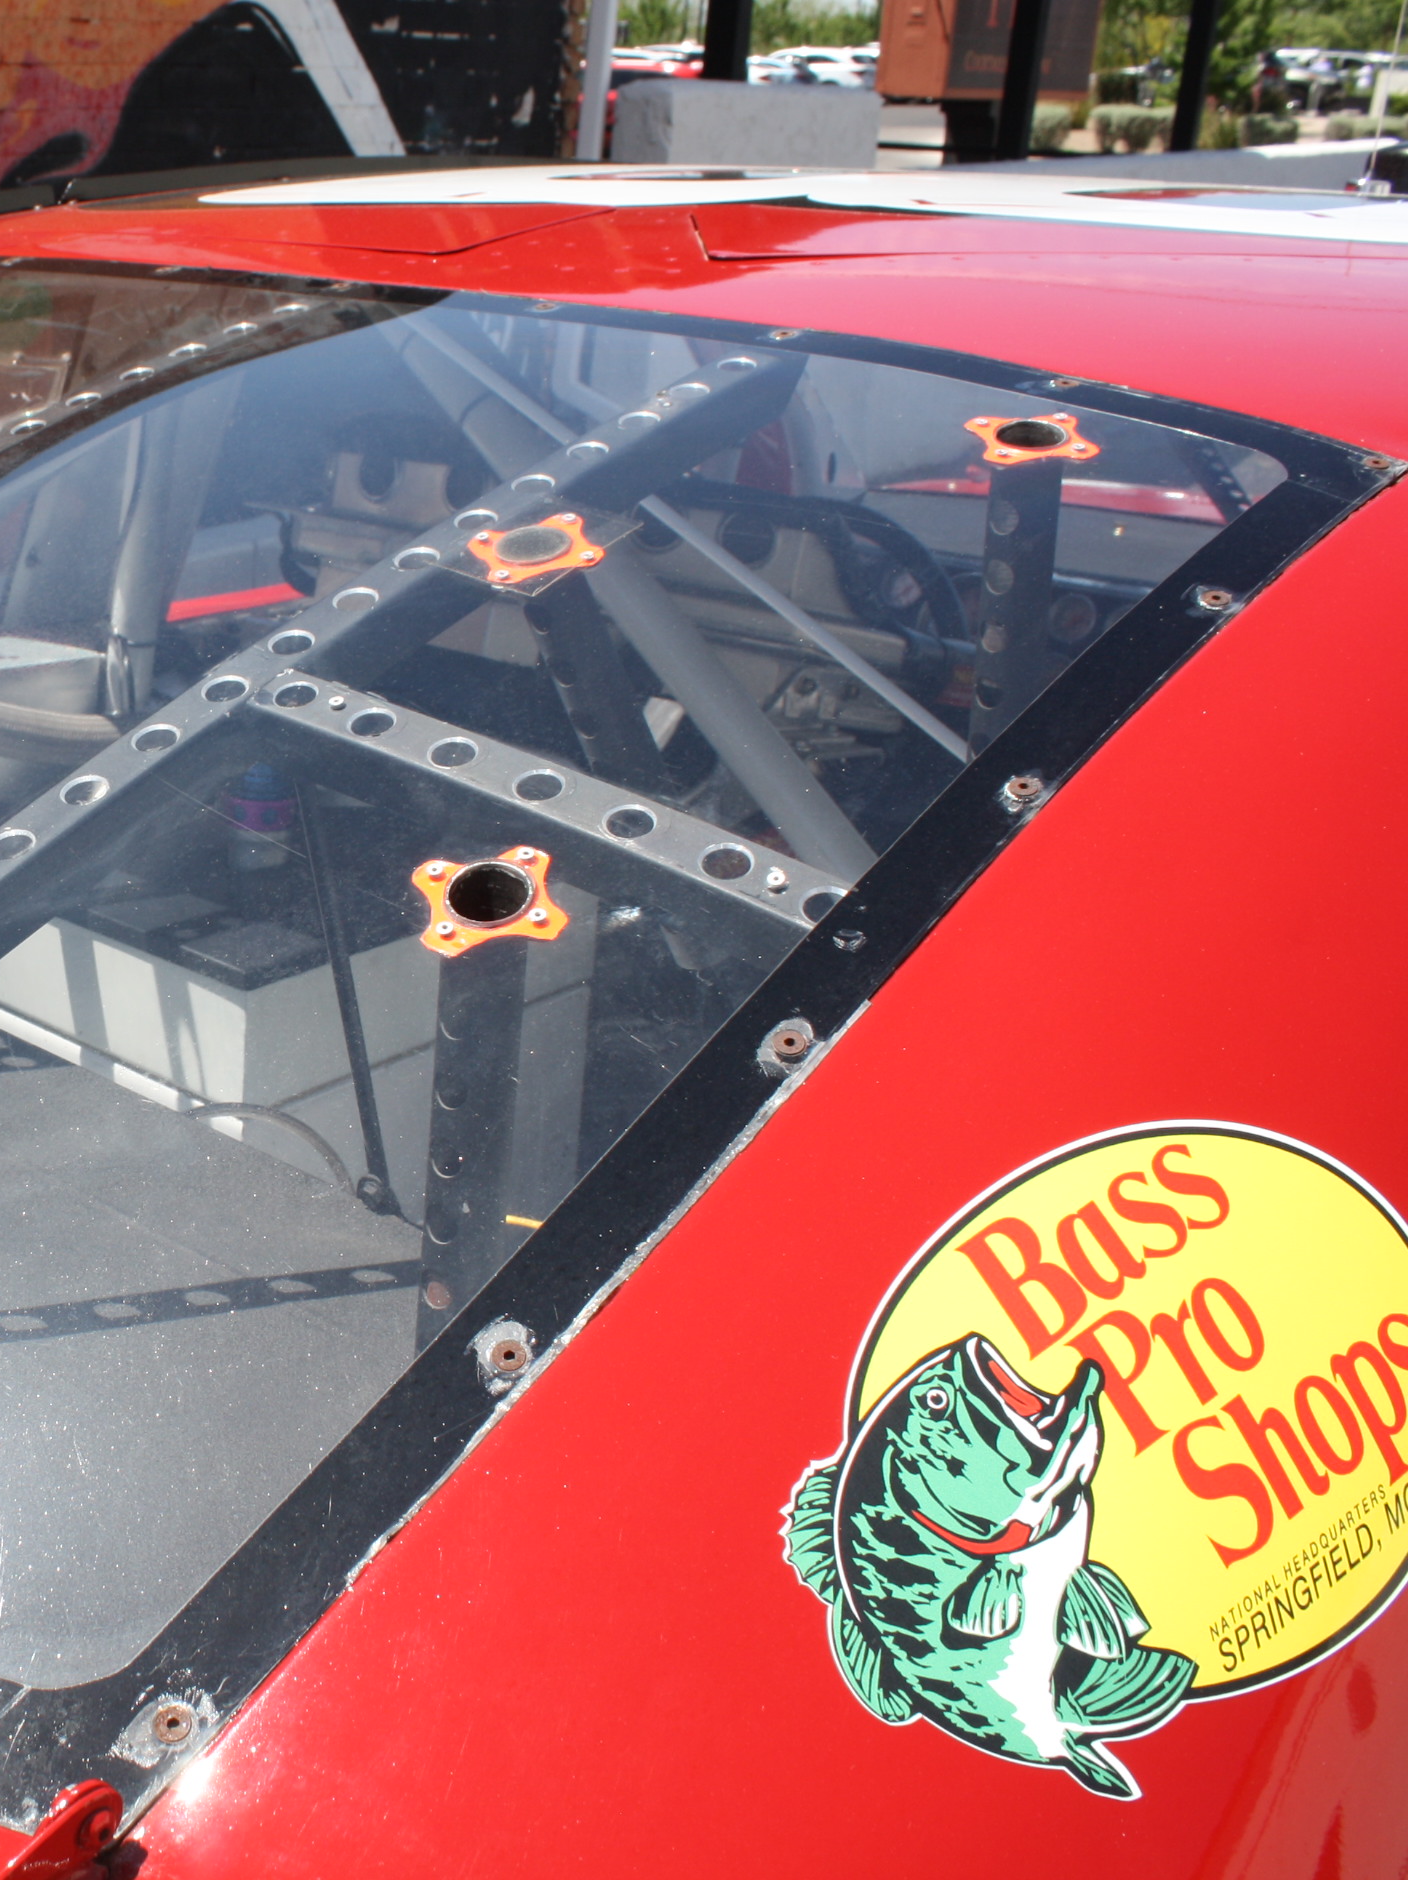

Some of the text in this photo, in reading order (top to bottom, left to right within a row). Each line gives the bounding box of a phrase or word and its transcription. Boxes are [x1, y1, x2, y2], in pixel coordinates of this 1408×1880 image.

[955, 1145, 1230, 1360] Bass
[1065, 1278, 1264, 1456] Pro
[1209, 1484, 1386, 1641] NATIONAL HEADQUARTERS
[1218, 1522, 1383, 1672] SPRINGFIELD,
